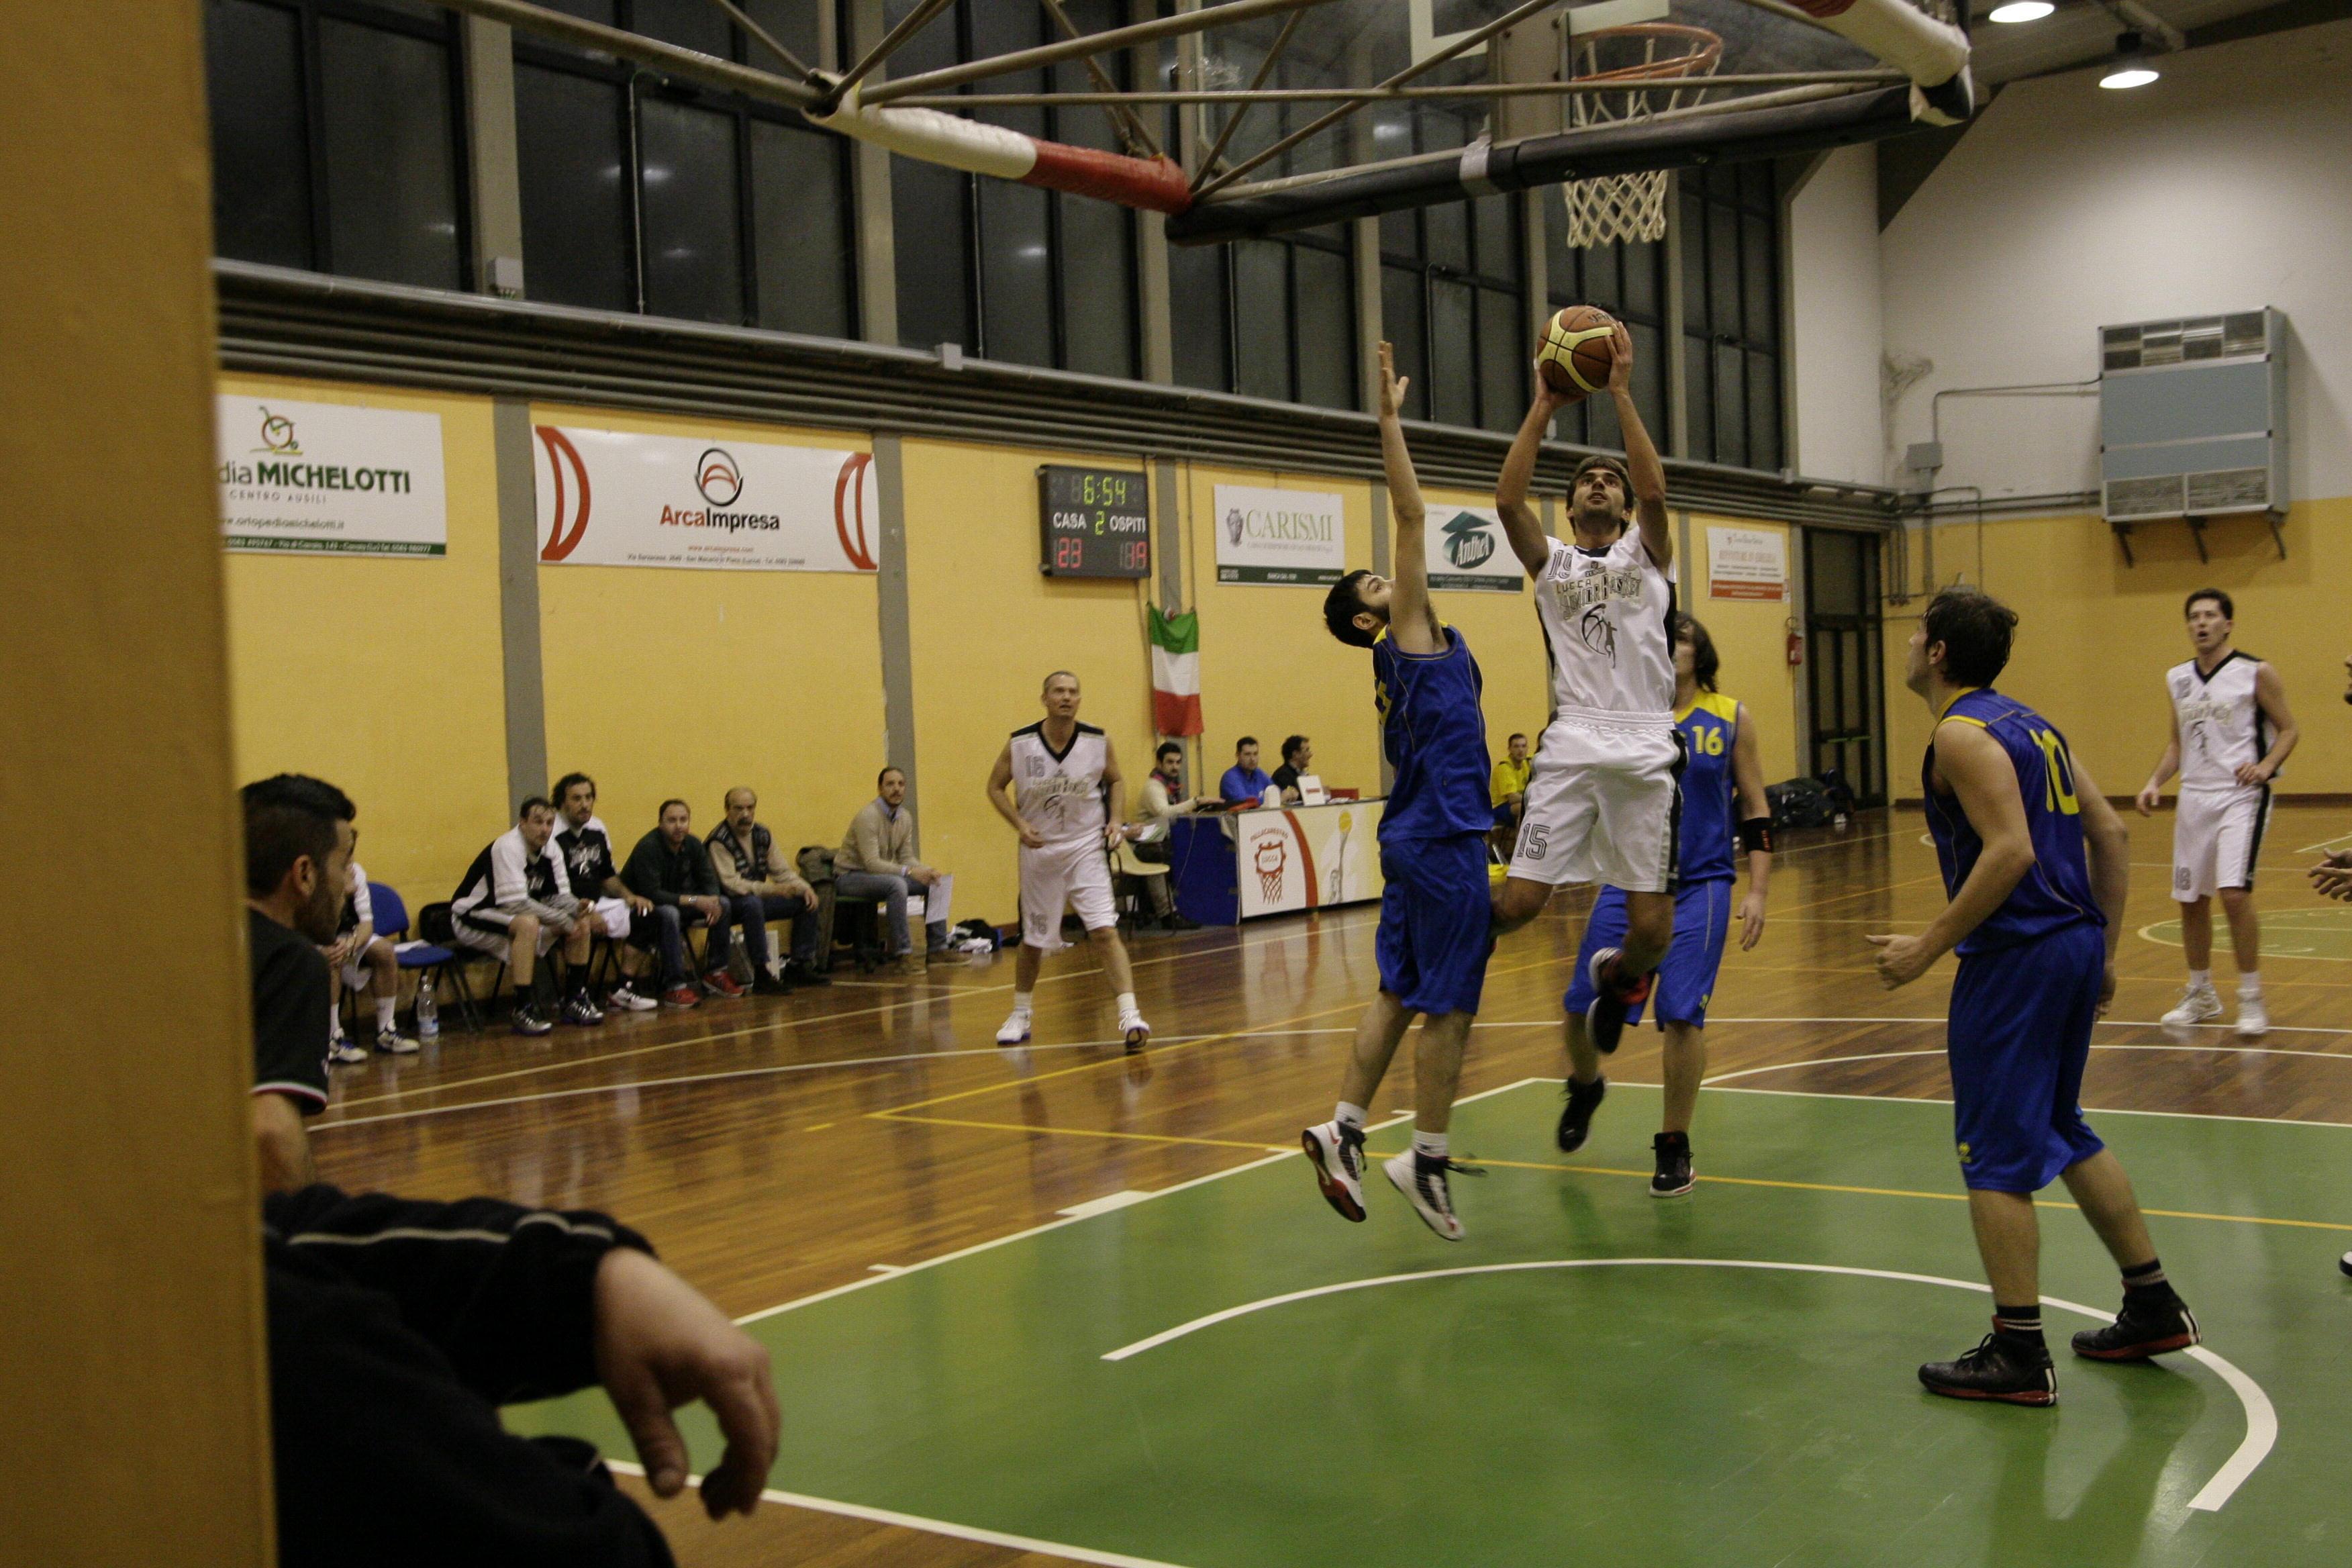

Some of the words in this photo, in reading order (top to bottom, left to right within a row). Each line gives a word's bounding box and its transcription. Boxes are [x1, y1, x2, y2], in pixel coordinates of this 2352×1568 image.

[257, 462, 411, 493] MICHELOTTI
[1083, 475, 1126, 506] 6:54
[230, 489, 281, 501] CENTRO
[660, 505, 779, 533] ArcaImpresa
[1052, 512, 1087, 530] CASA
[1095, 510, 1105, 536] 2
[1110, 516, 1146, 533] OSPITI
[1246, 509, 1333, 541] CARISMI
[1057, 538, 1083, 569] 23
[1556, 579, 1592, 595] LUCCA
[1691, 725, 1724, 756] 16
[1025, 754, 1045, 777] 16
[2028, 728, 2079, 816] 10
[1516, 822, 1551, 860] 15
